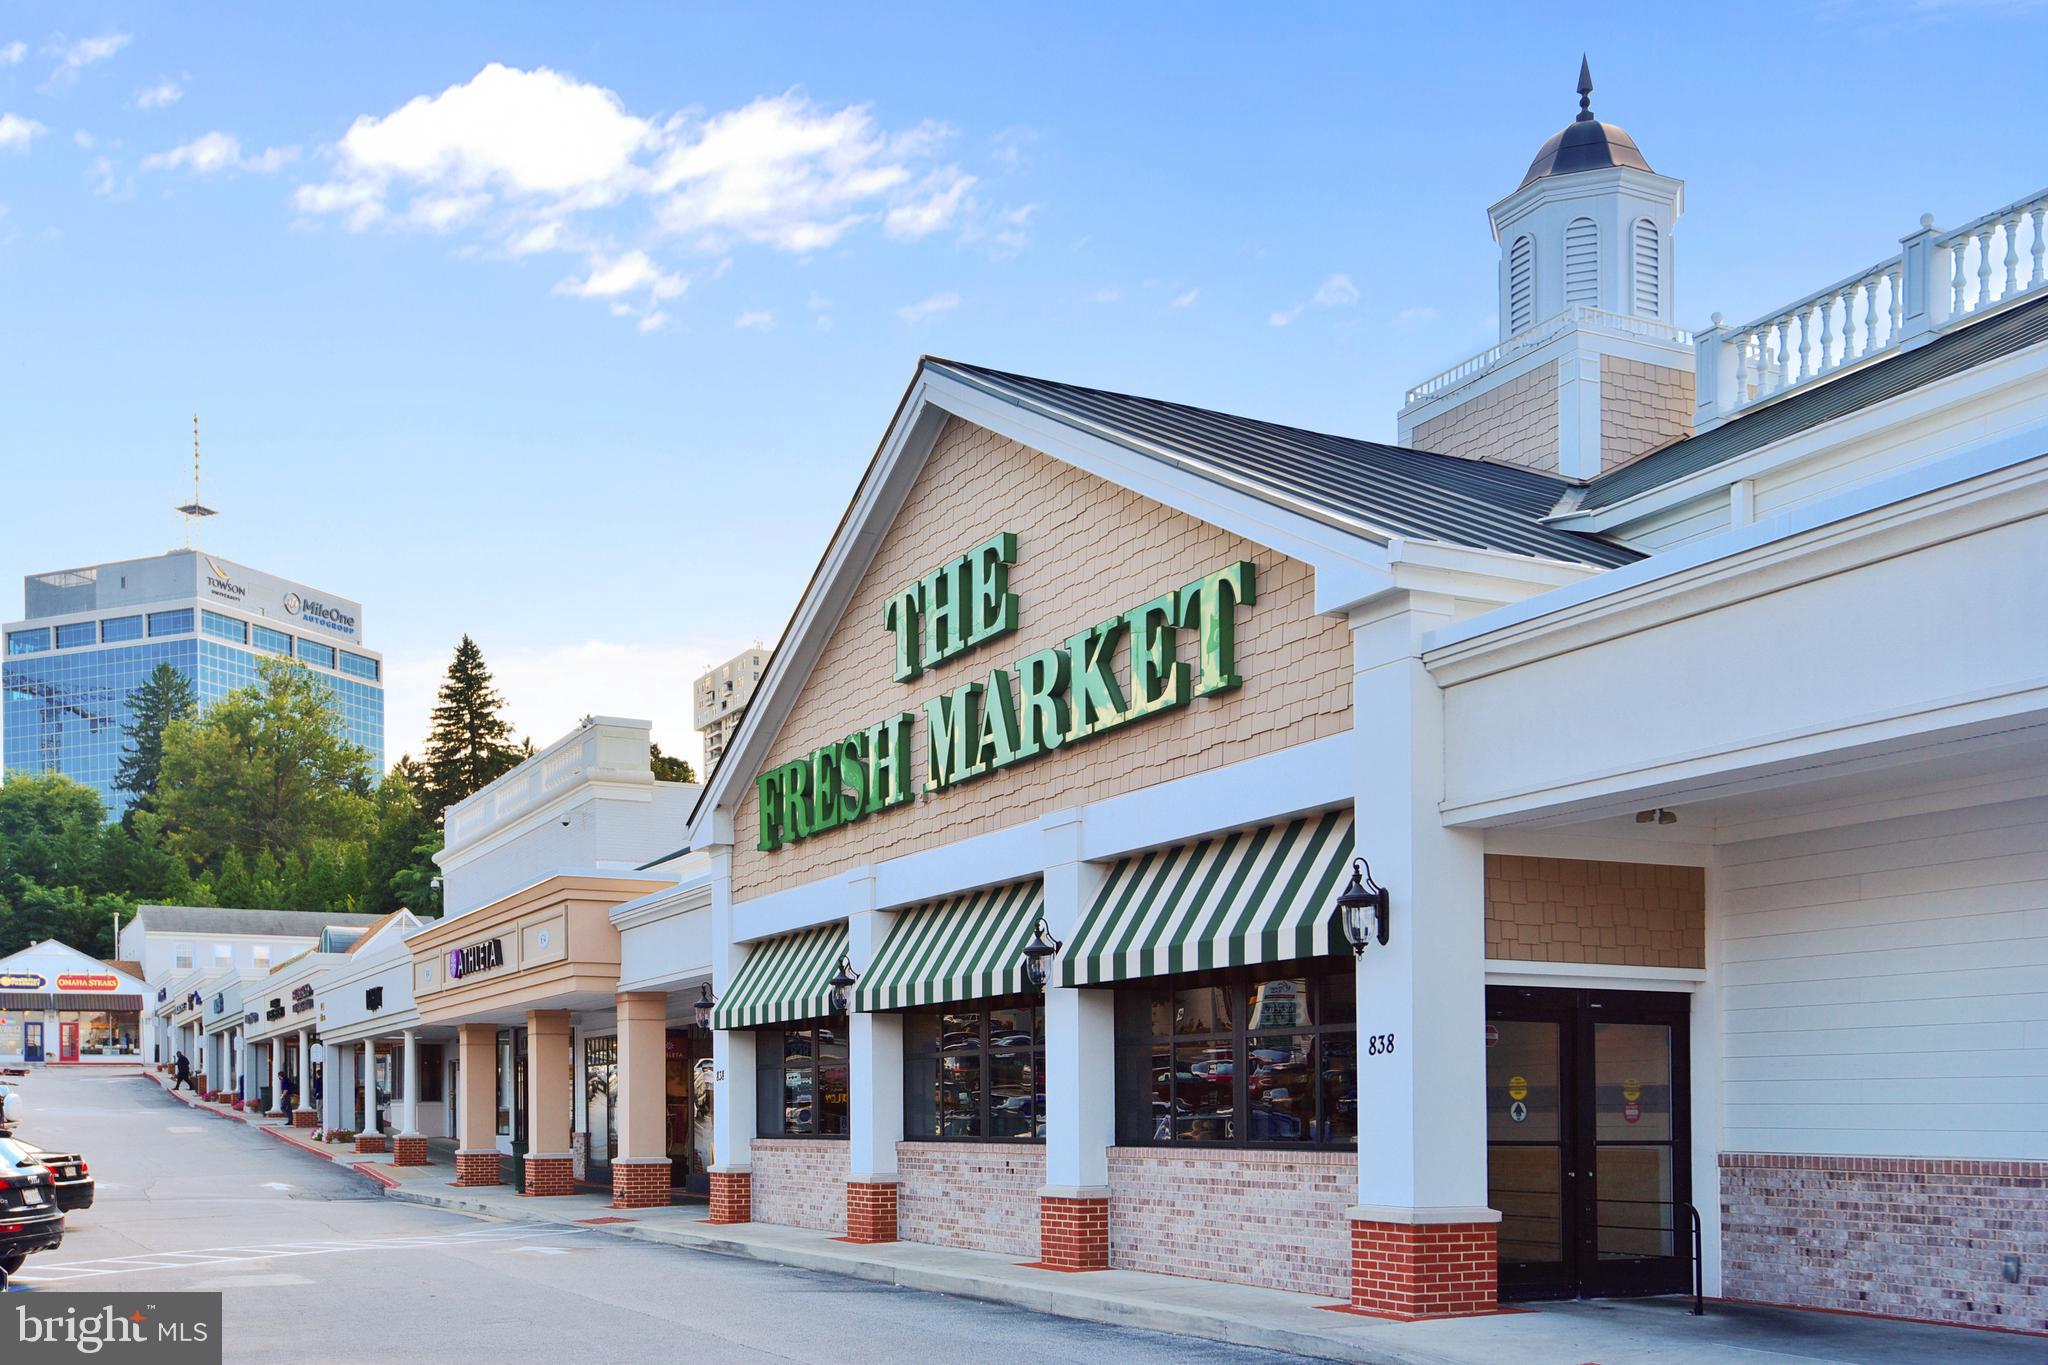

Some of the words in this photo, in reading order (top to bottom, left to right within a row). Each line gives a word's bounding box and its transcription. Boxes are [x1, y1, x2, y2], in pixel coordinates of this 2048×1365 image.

[207, 576, 246, 597] TOWSON
[303, 598, 355, 627] MileOne
[884, 532, 1019, 684] THE
[303, 614, 355, 634] AUTOGROUP
[757, 713, 915, 852] FRESH
[923, 560, 1257, 794] MARKET
[458, 939, 503, 976] ATHLETA
[59, 979, 88, 987] OMAHA
[88, 979, 117, 987] STEAKS
[1368, 1033, 1395, 1056] 838
